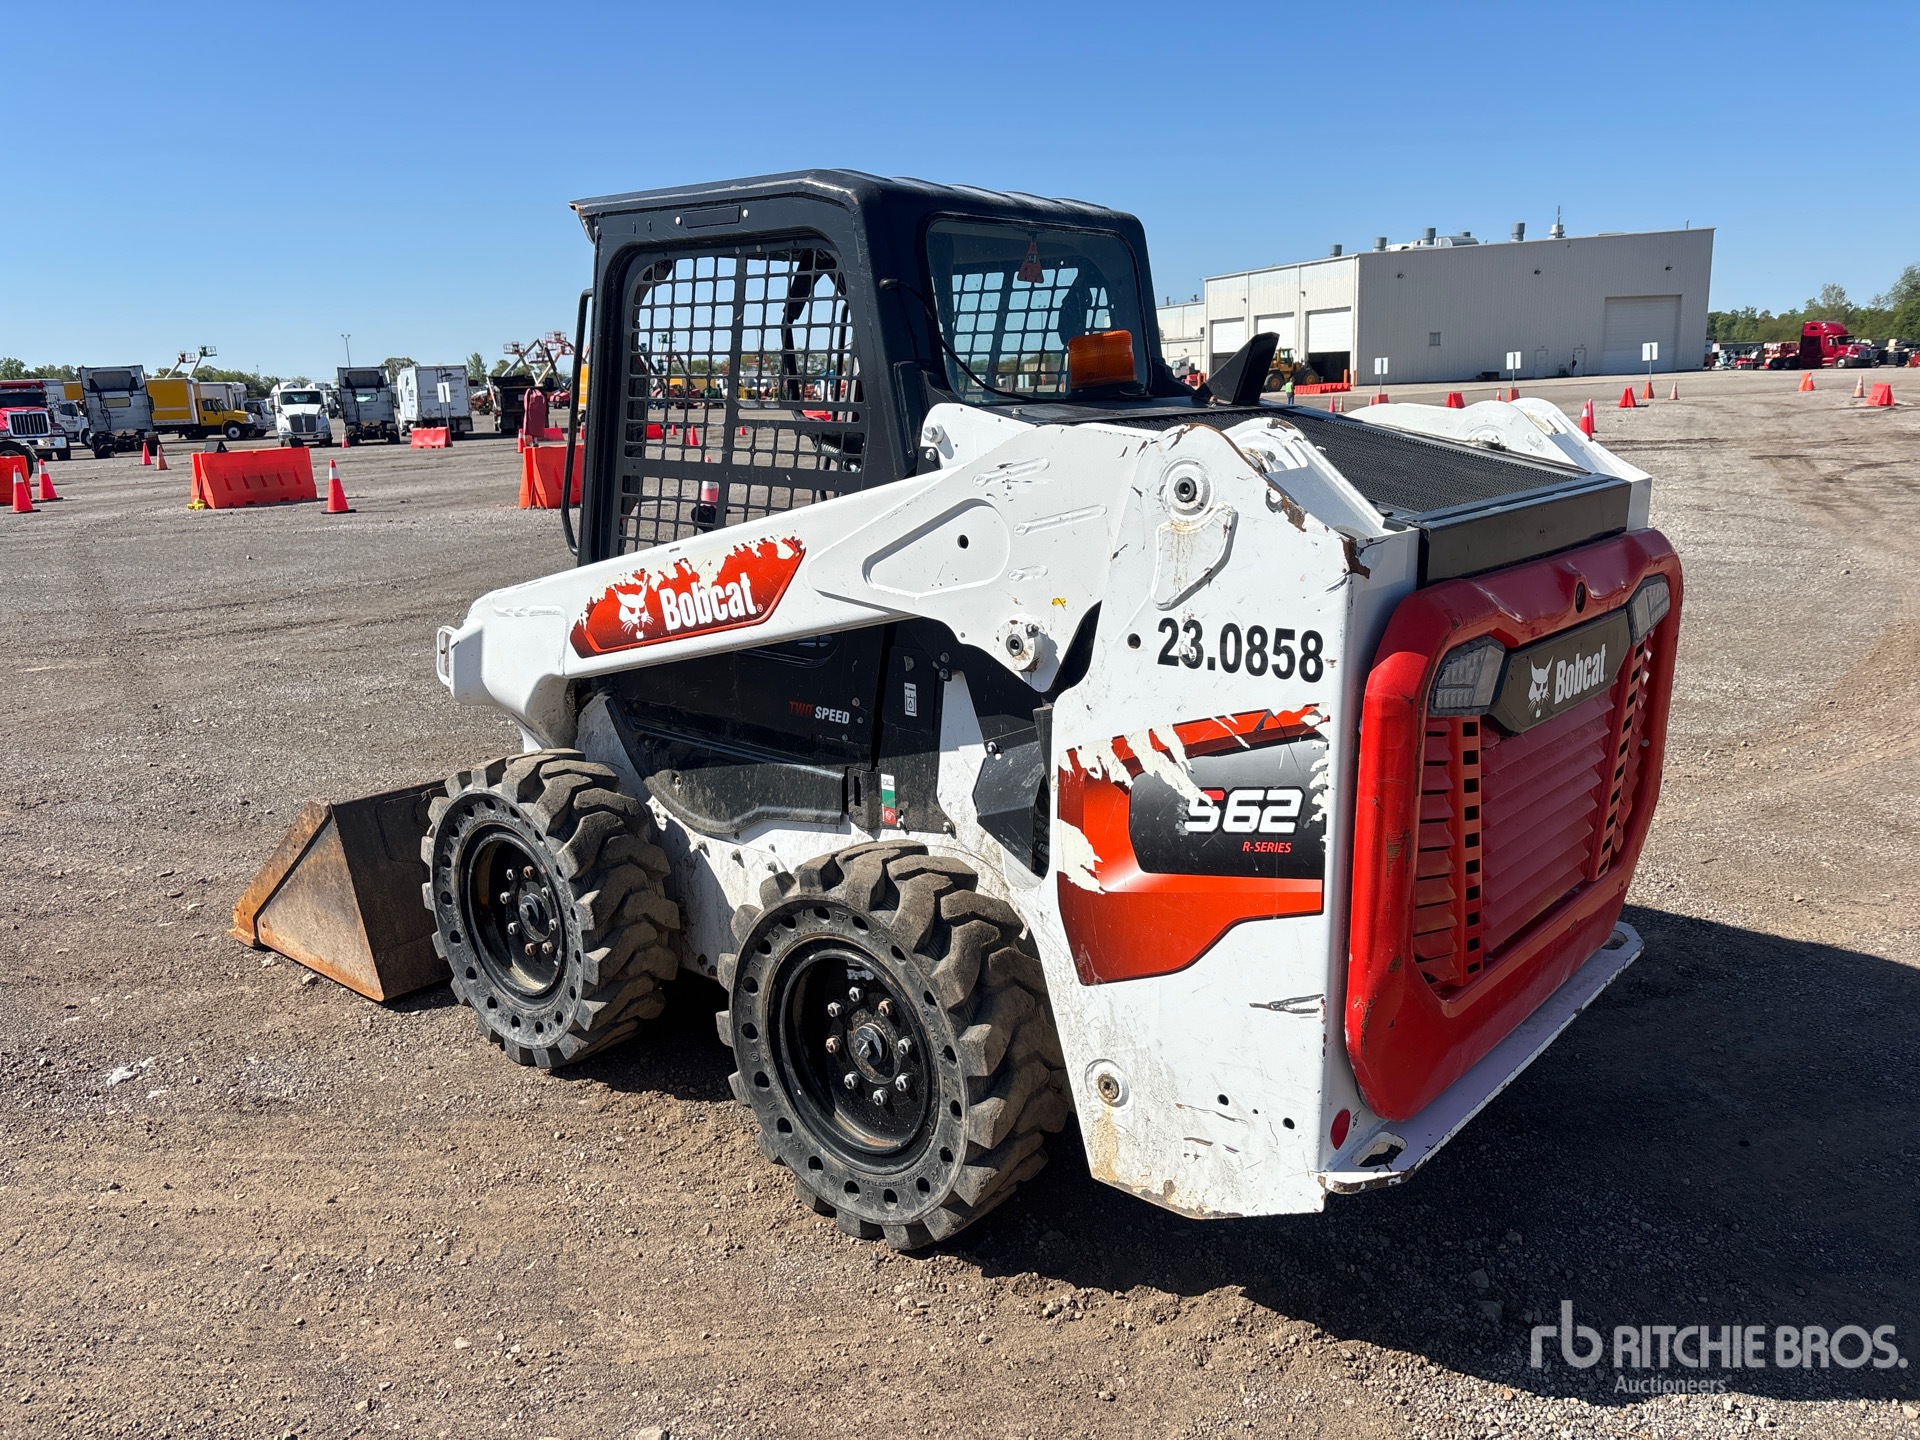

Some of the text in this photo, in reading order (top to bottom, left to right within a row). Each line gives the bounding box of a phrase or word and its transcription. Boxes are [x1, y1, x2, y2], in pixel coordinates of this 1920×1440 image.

[658, 571, 757, 631] Bobcat
[1157, 617, 1324, 684] 23.0858
[1554, 643, 1606, 705] Bobcat
[789, 701, 851, 725] TWO SPEED
[1242, 841, 1292, 853] R-SERIES
